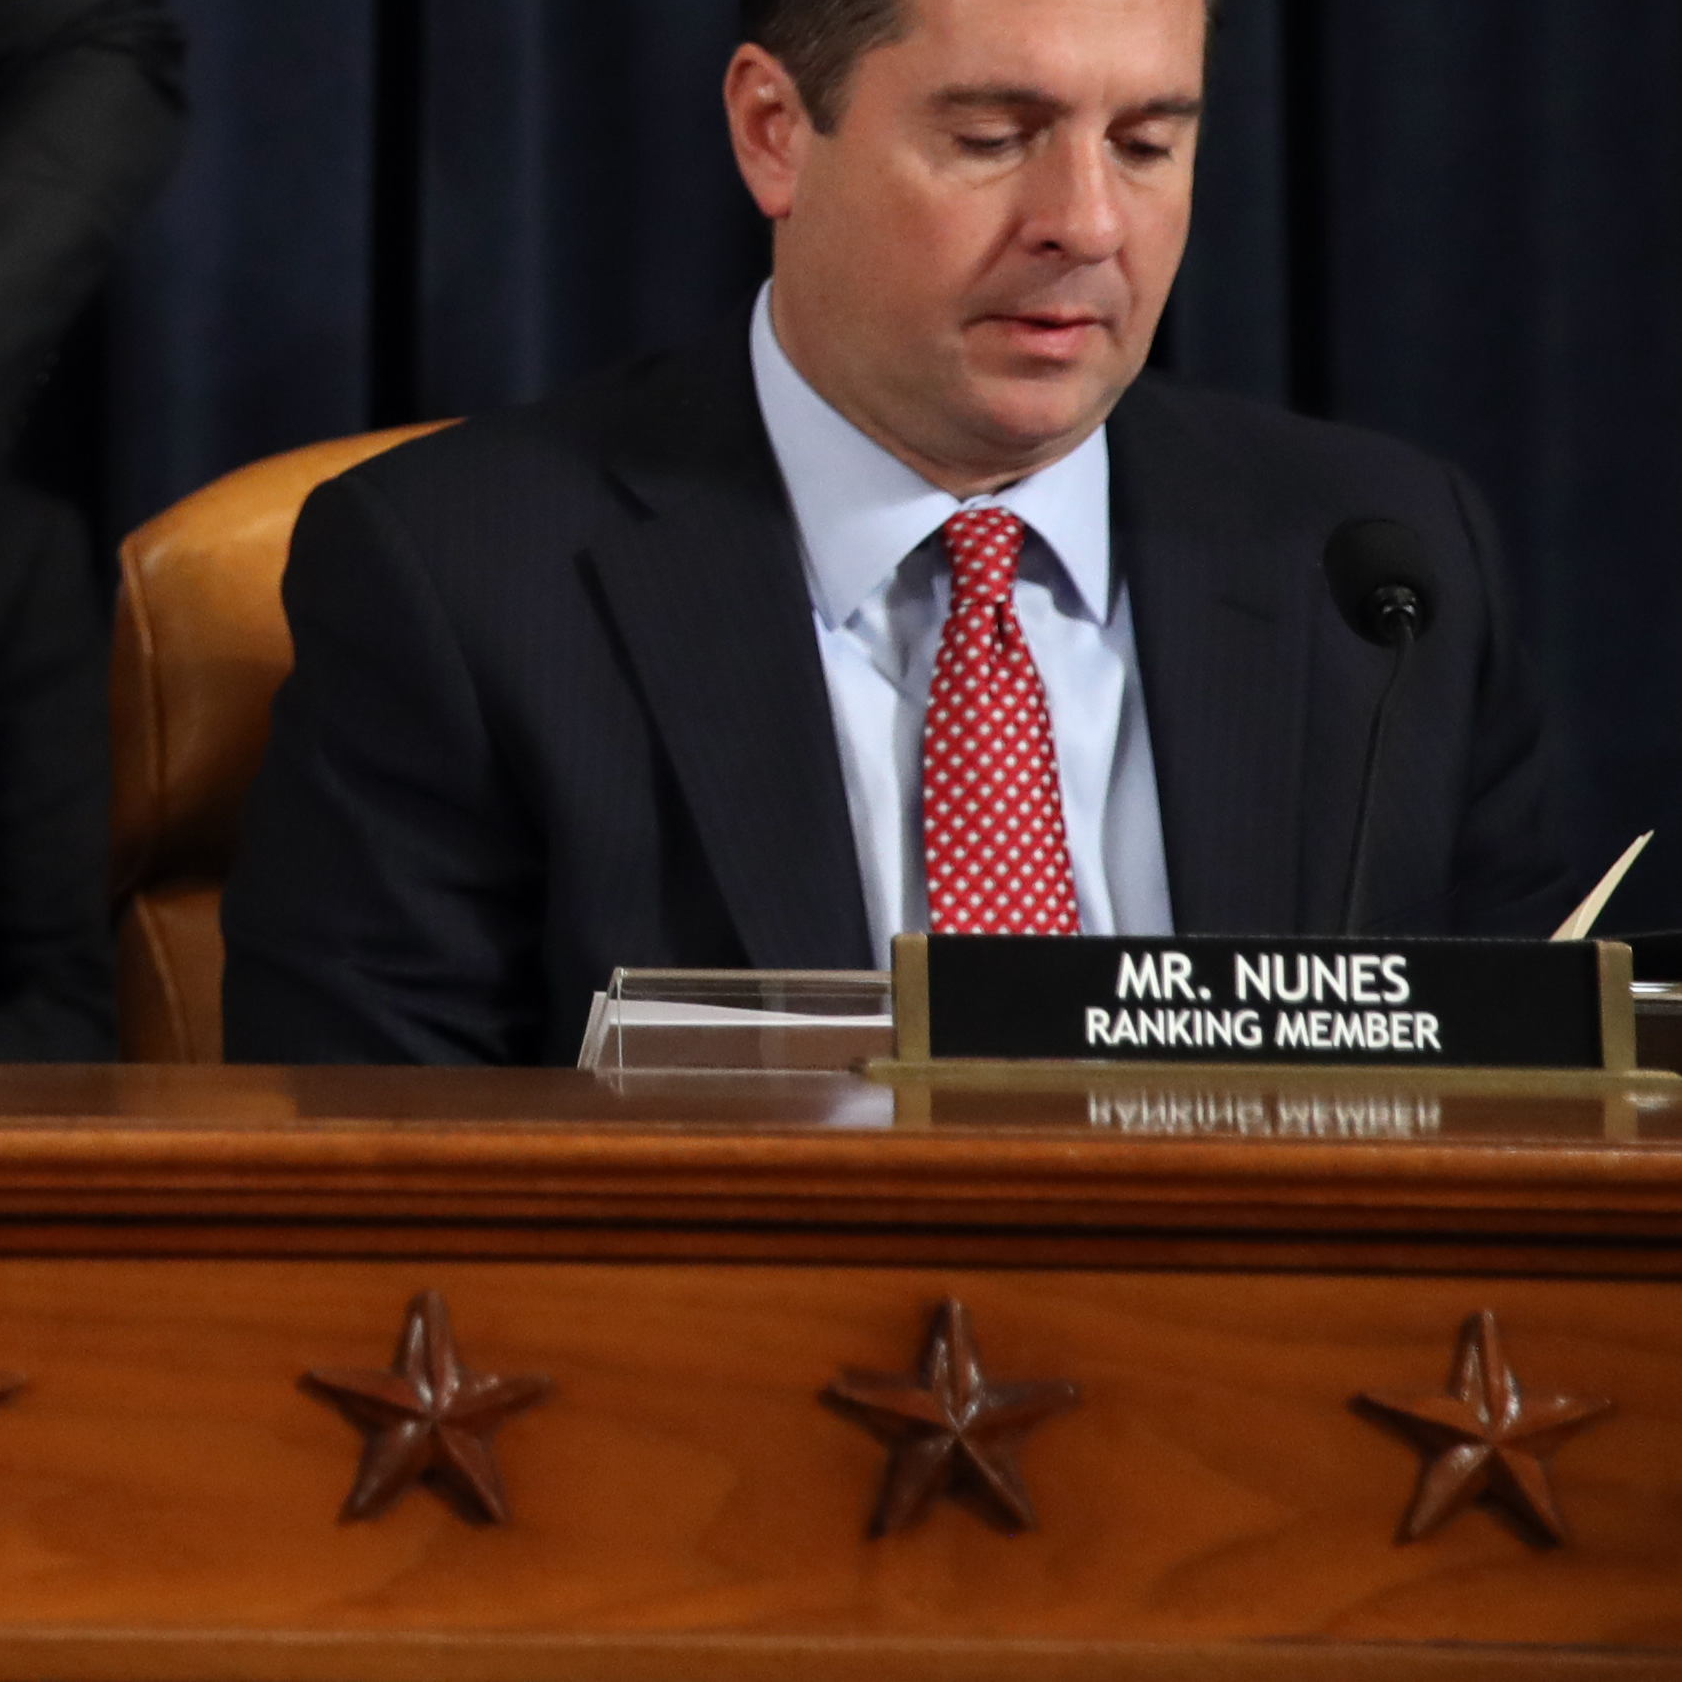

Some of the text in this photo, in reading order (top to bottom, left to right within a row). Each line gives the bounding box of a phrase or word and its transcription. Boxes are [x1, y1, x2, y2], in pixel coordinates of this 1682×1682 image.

[1116, 951, 1410, 1004] MR. NUNES
[1086, 1007, 1442, 1050] RANKING MEMBER
